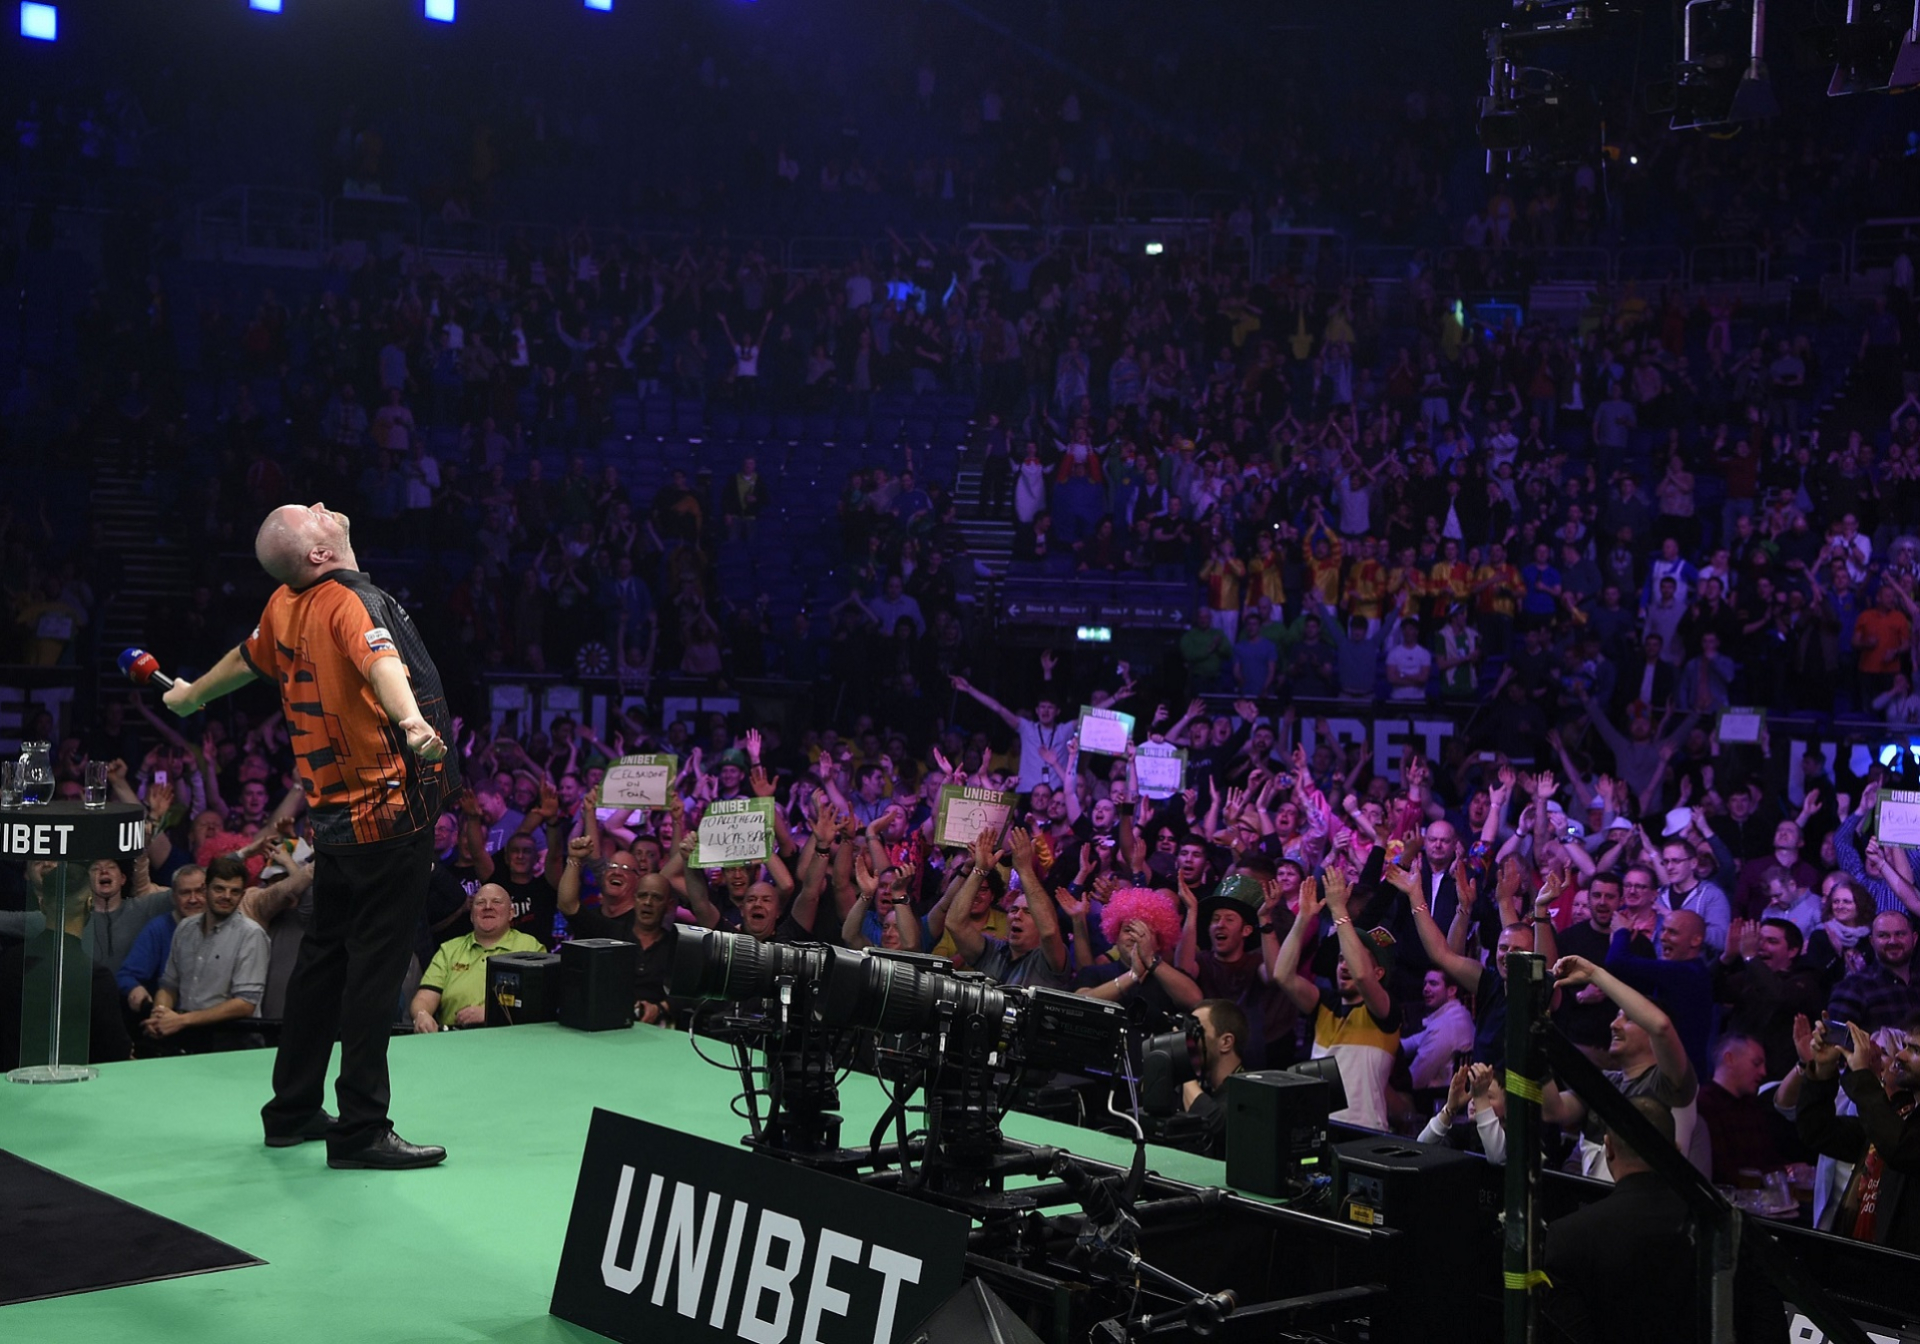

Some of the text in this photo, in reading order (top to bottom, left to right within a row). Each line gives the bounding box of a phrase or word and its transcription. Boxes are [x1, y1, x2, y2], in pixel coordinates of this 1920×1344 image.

[619, 754, 657, 765] UNIBET
[618, 788, 651, 800] TOUR
[963, 787, 1004, 803] UNIBET
[711, 799, 751, 814] UNIBET
[600, 1164, 922, 1344] UNIBET
